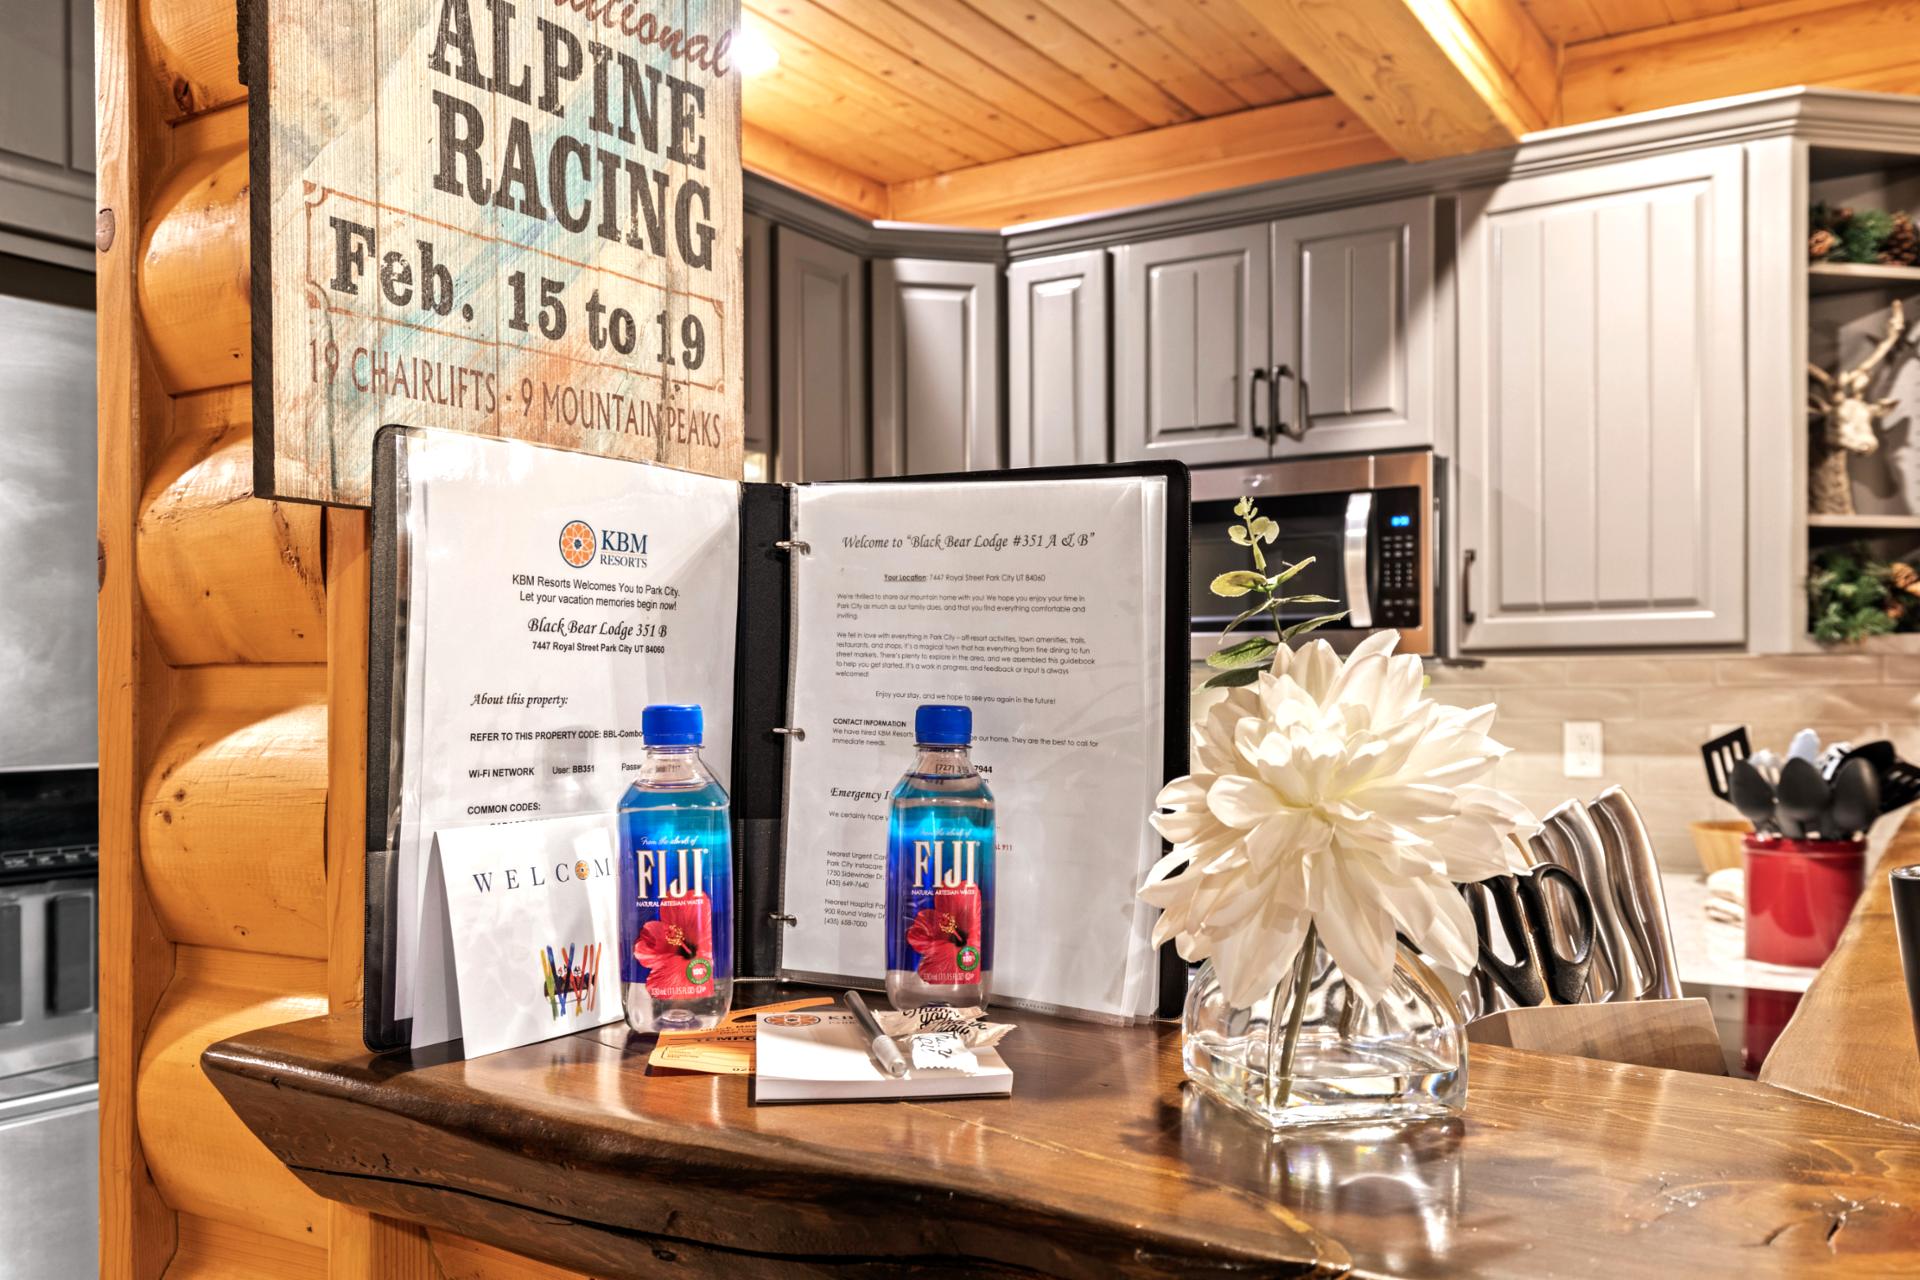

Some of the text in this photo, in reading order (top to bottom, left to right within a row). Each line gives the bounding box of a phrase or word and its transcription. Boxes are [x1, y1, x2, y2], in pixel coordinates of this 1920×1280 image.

[428, 0, 706, 170] ALPINE
[433, 89, 716, 272] RACING
[328, 215, 705, 370] Feb. 15 to 19
[308, 339, 721, 450] 19 CHAIRLIFTS 9 MOUNTAIN PEAKS
[601, 529, 648, 554] KBM
[842, 535, 888, 549] Welcome
[892, 537, 903, 548] to
[946, 535, 970, 548] Bear
[974, 533, 1008, 551] Lodge
[1013, 534, 1042, 547] #351
[1045, 534, 1057, 549] A
[1061, 533, 1075, 547] &
[600, 554, 648, 568] RESORTS
[512, 574, 680, 598] KBM Resorts Welcomes You to Park City.
[884, 574, 899, 582] Your
[965, 574, 984, 582] Street
[1001, 574, 1015, 583] City
[1016, 574, 1023, 582] UT
[520, 591, 677, 611] Let your vacation memories begin now!
[528, 617, 667, 640] Black Bear Lodge 351 B
[532, 641, 550, 650] 7447
[552, 642, 575, 652] Royal
[577, 643, 599, 652] Street
[601, 644, 616, 652] Park
[618, 645, 632, 654] City
[634, 645, 643, 653] UT
[470, 693, 568, 708] About this property:
[470, 733, 499, 742] REFER
[515, 732, 533, 740] THIS
[535, 731, 576, 739] PROPERTY
[578, 731, 601, 739] CODE:
[469, 767, 534, 778] Wi-Fi NETWORK
[552, 765, 595, 775] User: BB351
[830, 787, 882, 803] Emergency
[467, 803, 541, 815] COMMON CODES:
[636, 848, 704, 898] FIJI
[913, 840, 977, 888] FIJI
[473, 858, 610, 893] WELCOM
